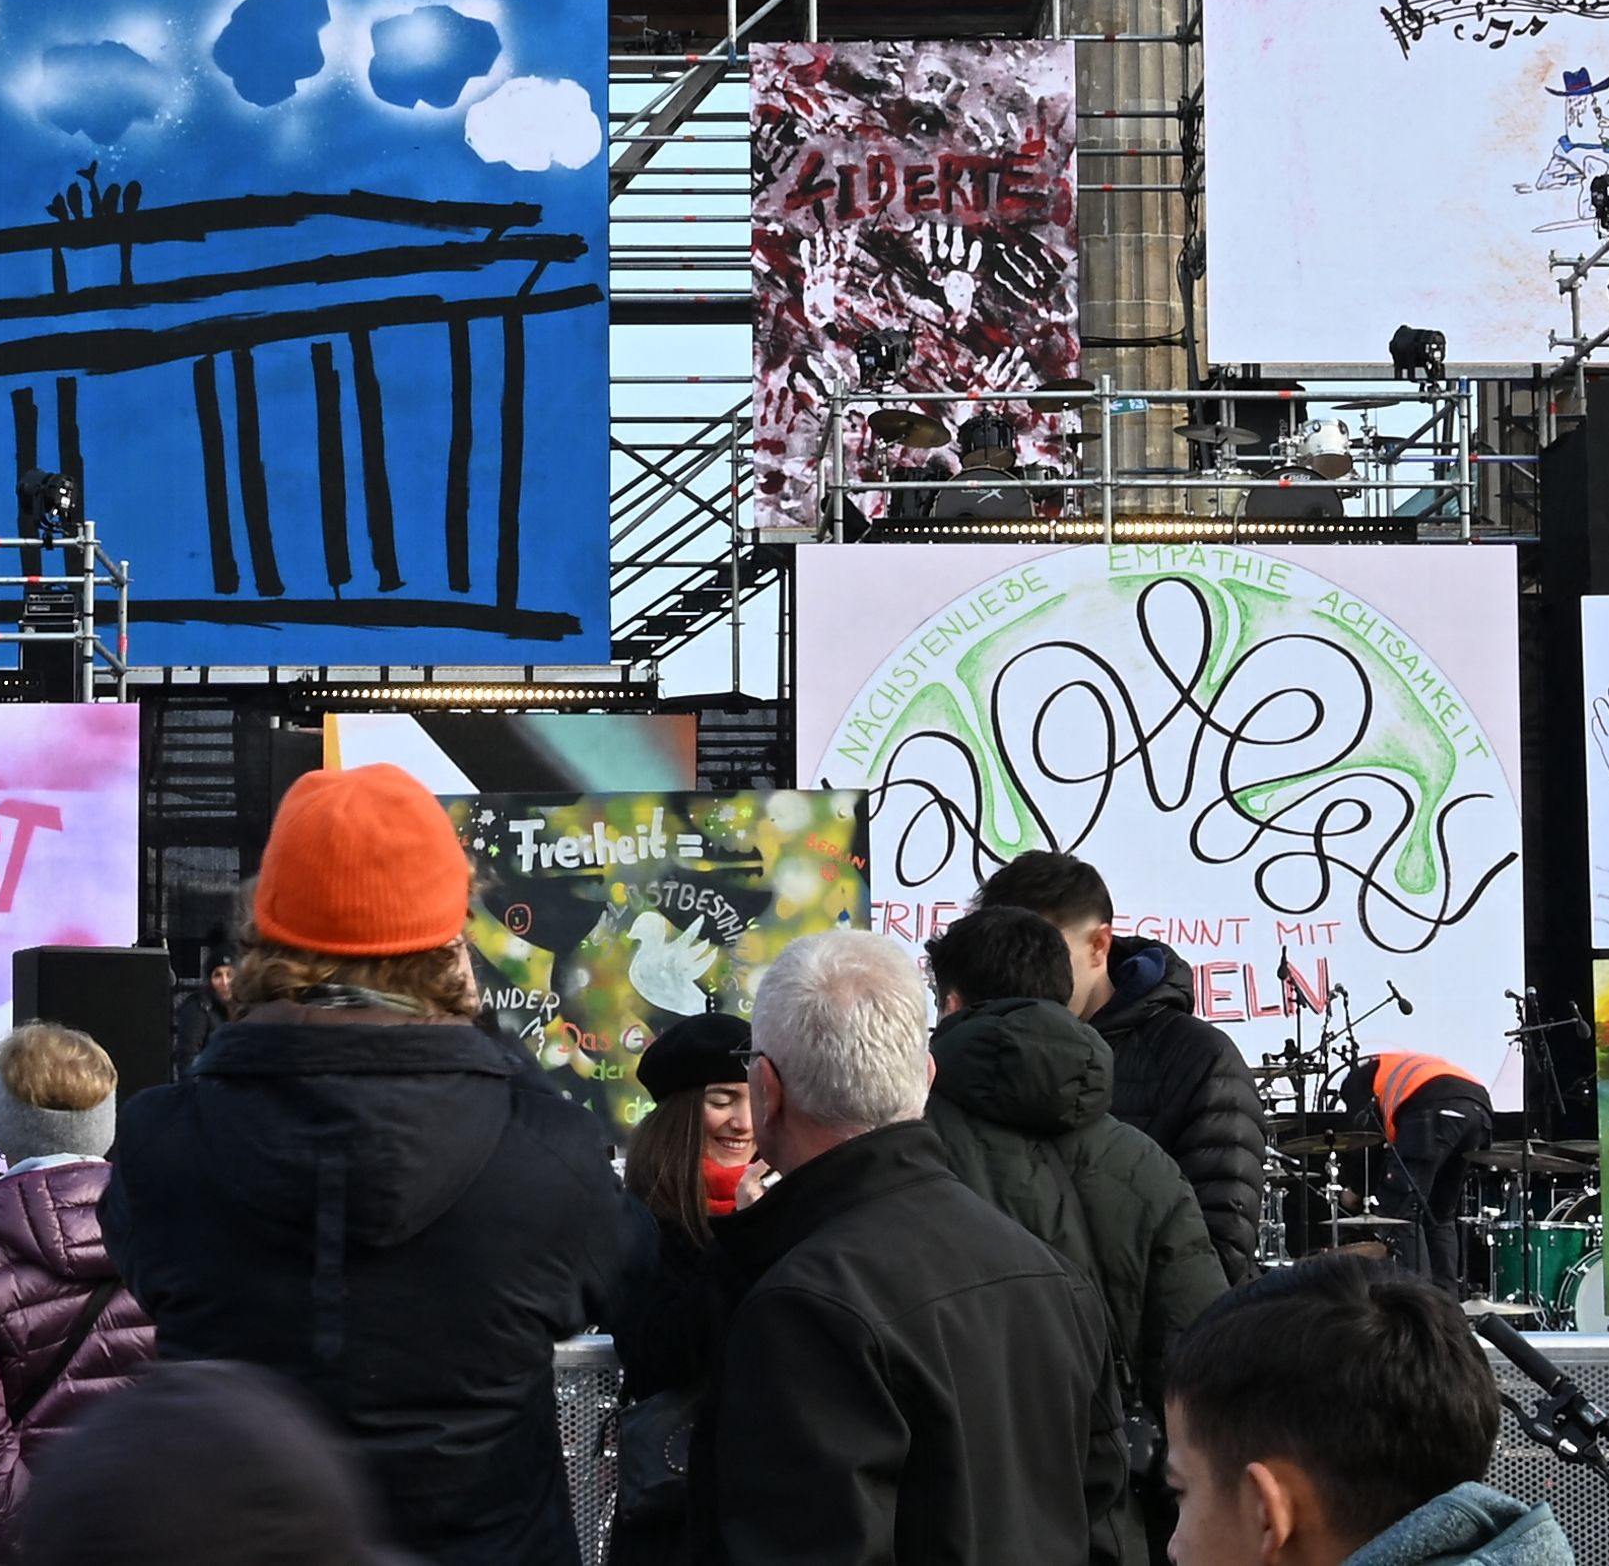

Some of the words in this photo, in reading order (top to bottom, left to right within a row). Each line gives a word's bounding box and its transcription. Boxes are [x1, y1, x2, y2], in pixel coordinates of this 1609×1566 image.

[1107, 542, 1295, 592] EMPATHIE
[836, 565, 1050, 766] NÄCHSTENLIEBE
[1318, 590, 1492, 763] ACHTSAMKEIT
[509, 807, 668, 873] Freiheit
[1276, 921, 1341, 947] MIT
